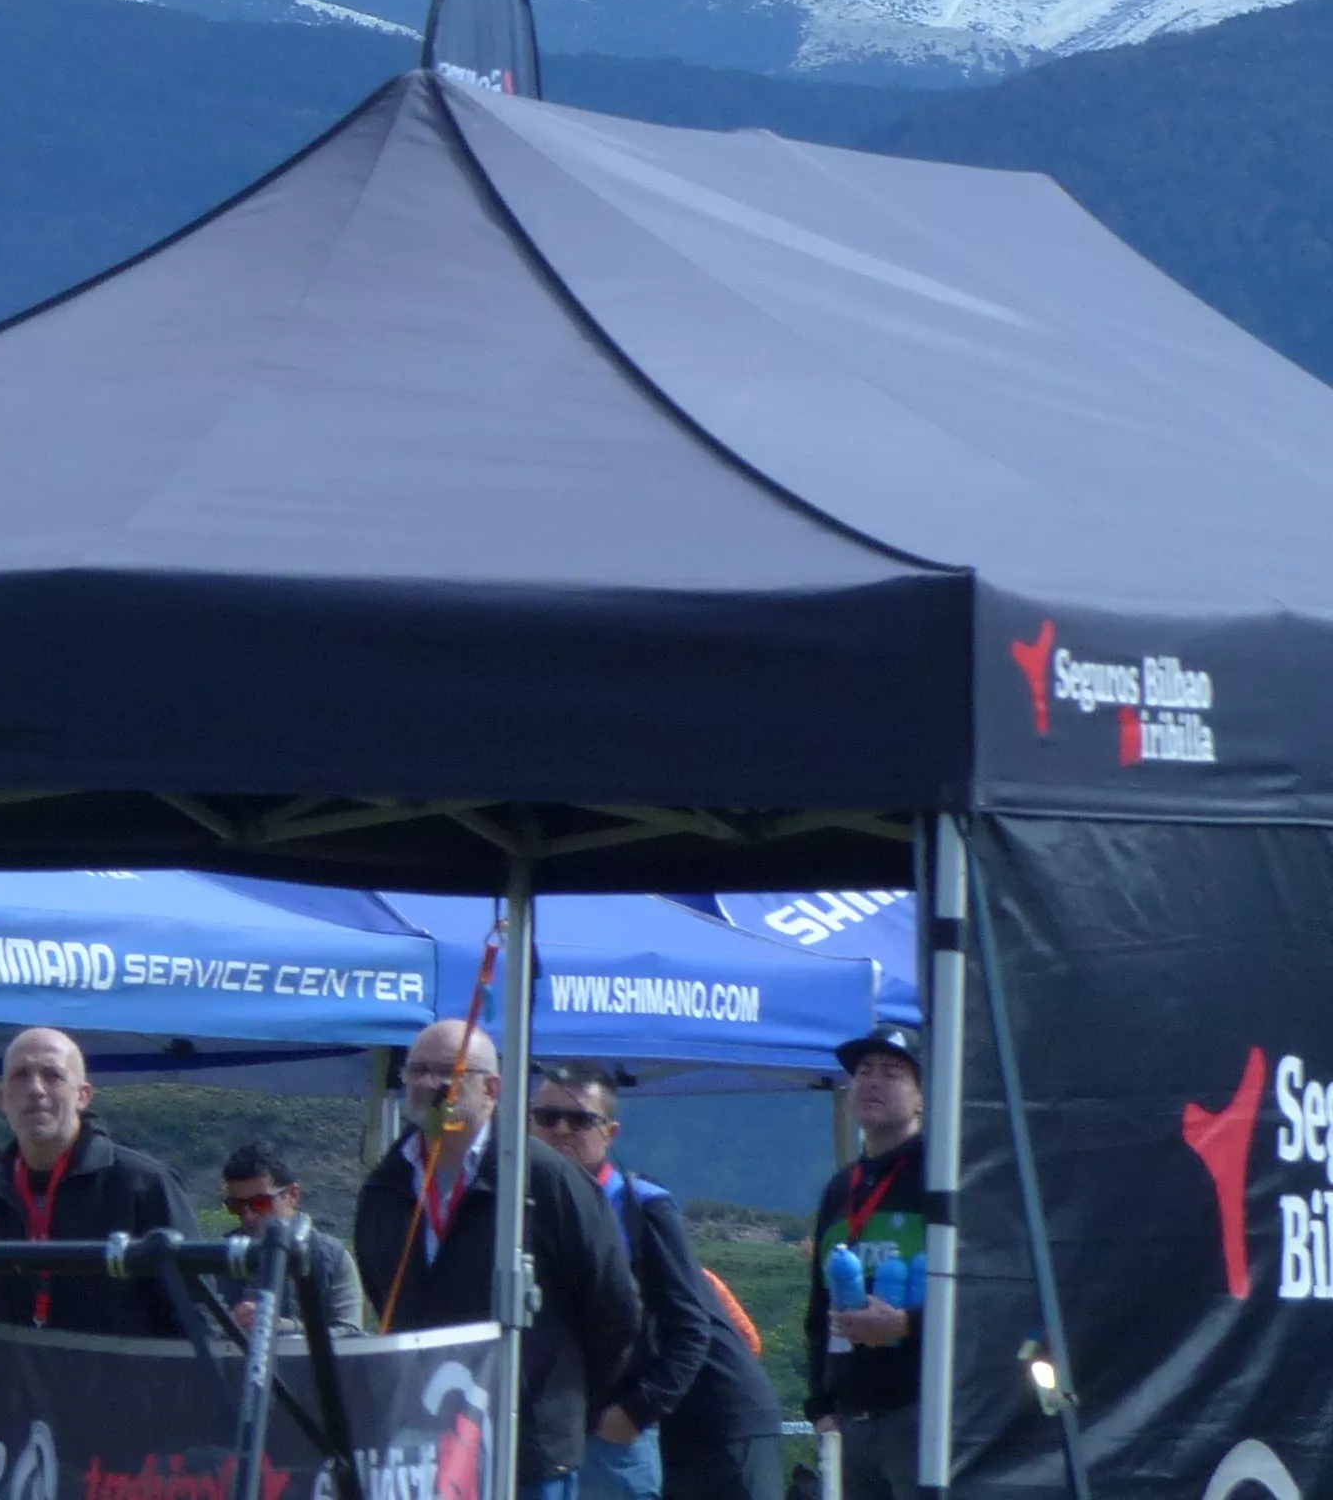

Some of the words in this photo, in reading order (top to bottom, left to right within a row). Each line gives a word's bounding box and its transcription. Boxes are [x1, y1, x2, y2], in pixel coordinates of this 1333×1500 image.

[1053, 648, 1140, 713] Seguros
[1142, 655, 1212, 709] Bilbao
[122, 953, 270, 993] SERVICE
[273, 966, 424, 1003] CENTER
[551, 975, 760, 1023] WWW.SHIMANO.COM
